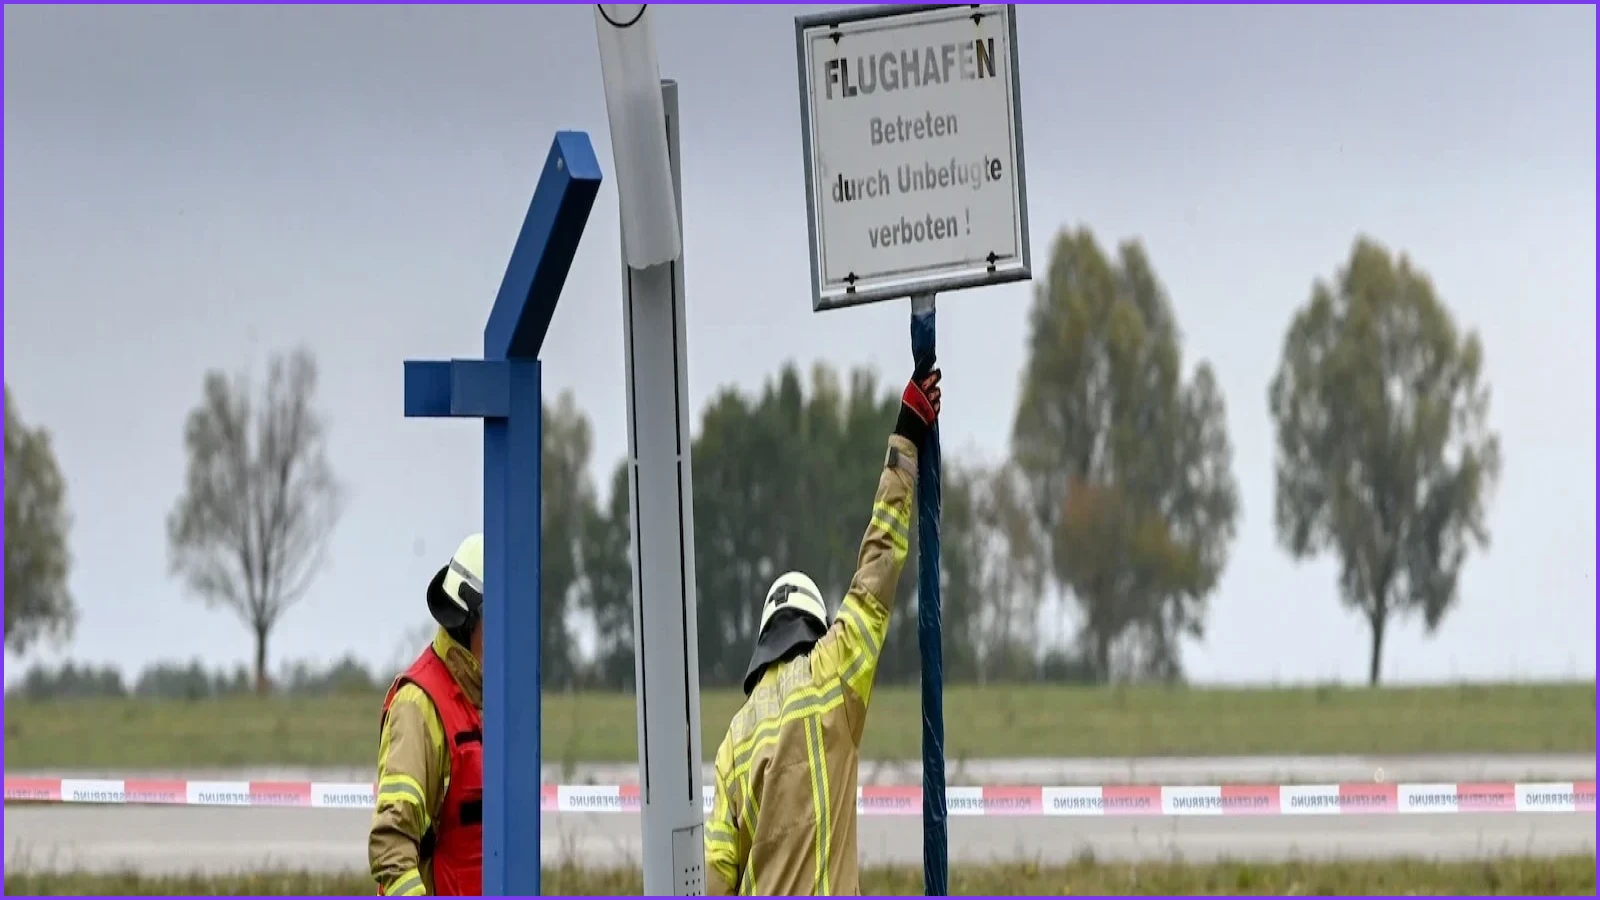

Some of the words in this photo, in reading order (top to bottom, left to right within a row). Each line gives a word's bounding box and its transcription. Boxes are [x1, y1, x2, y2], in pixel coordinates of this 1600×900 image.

[824, 38, 996, 100] FLUGHAFEN
[870, 111, 958, 146] Betreten
[832, 170, 890, 204] durch
[897, 154, 1002, 192] Unbefugte
[869, 214, 958, 249] verboten
[965, 207, 971, 236] !
